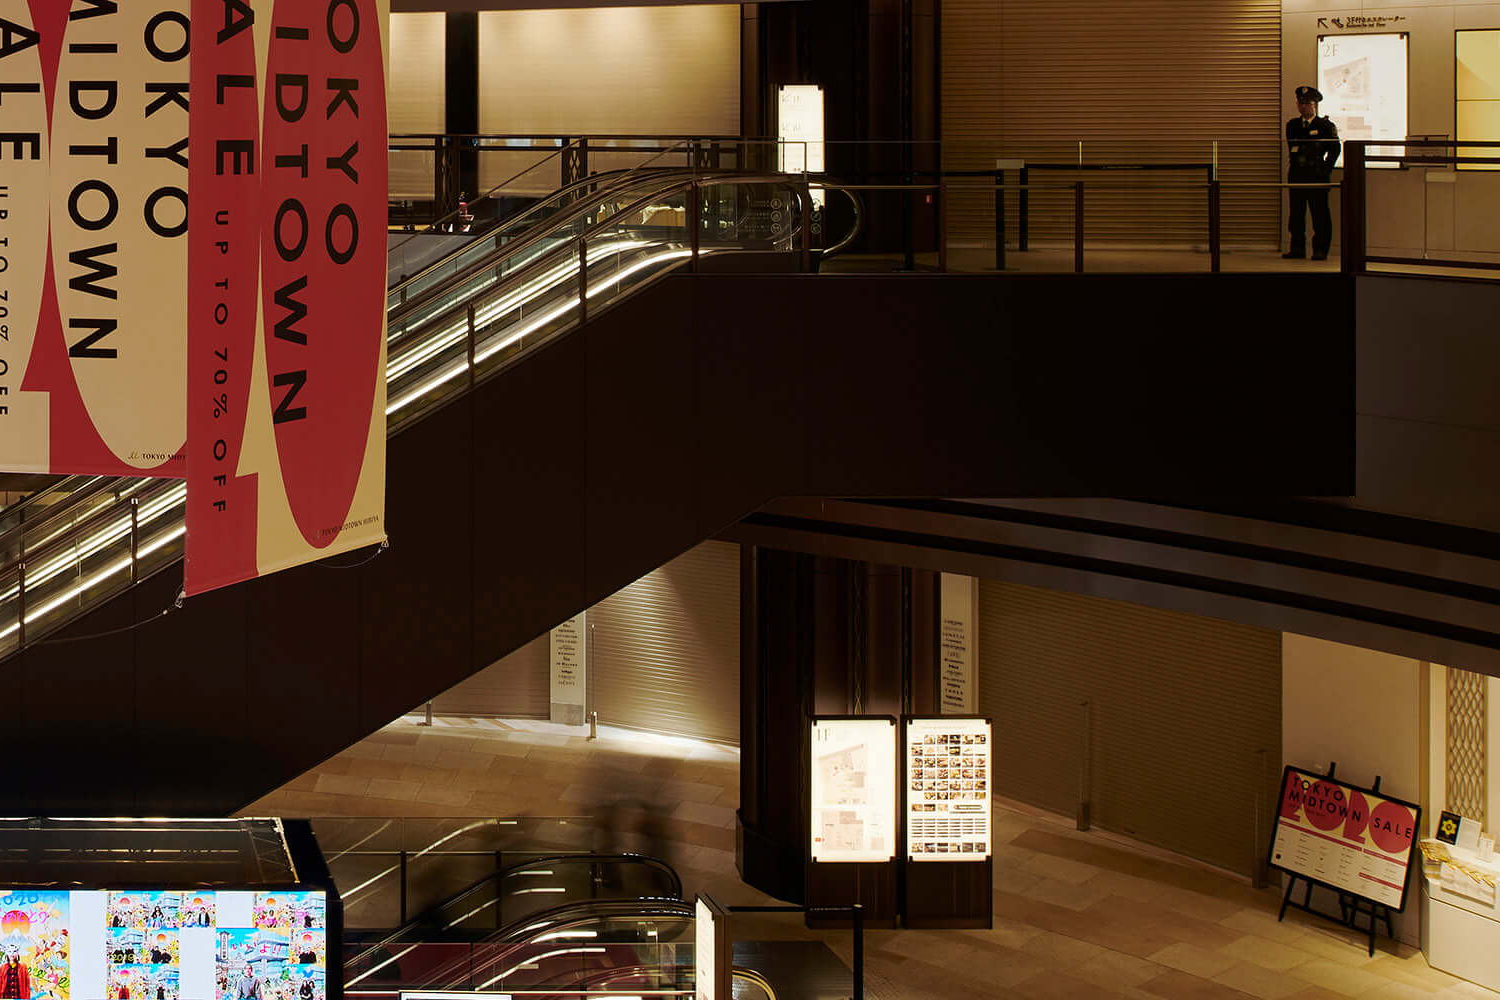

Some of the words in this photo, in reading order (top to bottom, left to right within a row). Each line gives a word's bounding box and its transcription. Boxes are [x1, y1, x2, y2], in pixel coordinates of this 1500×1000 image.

[216, 0, 254, 175] ALE
[144, 10, 191, 238] OKYO
[325, 0, 360, 265] OKYO
[214, 210, 229, 254] UP
[273, 26, 309, 425] IDTOWN
[214, 278, 229, 325] TO
[213, 347, 228, 418] 70%
[212, 439, 227, 512] OFF
[1288, 790, 1362, 822] MIDTOWN
[1373, 817, 1413, 839] SALE
[1292, 775, 1344, 802] TOKYO
